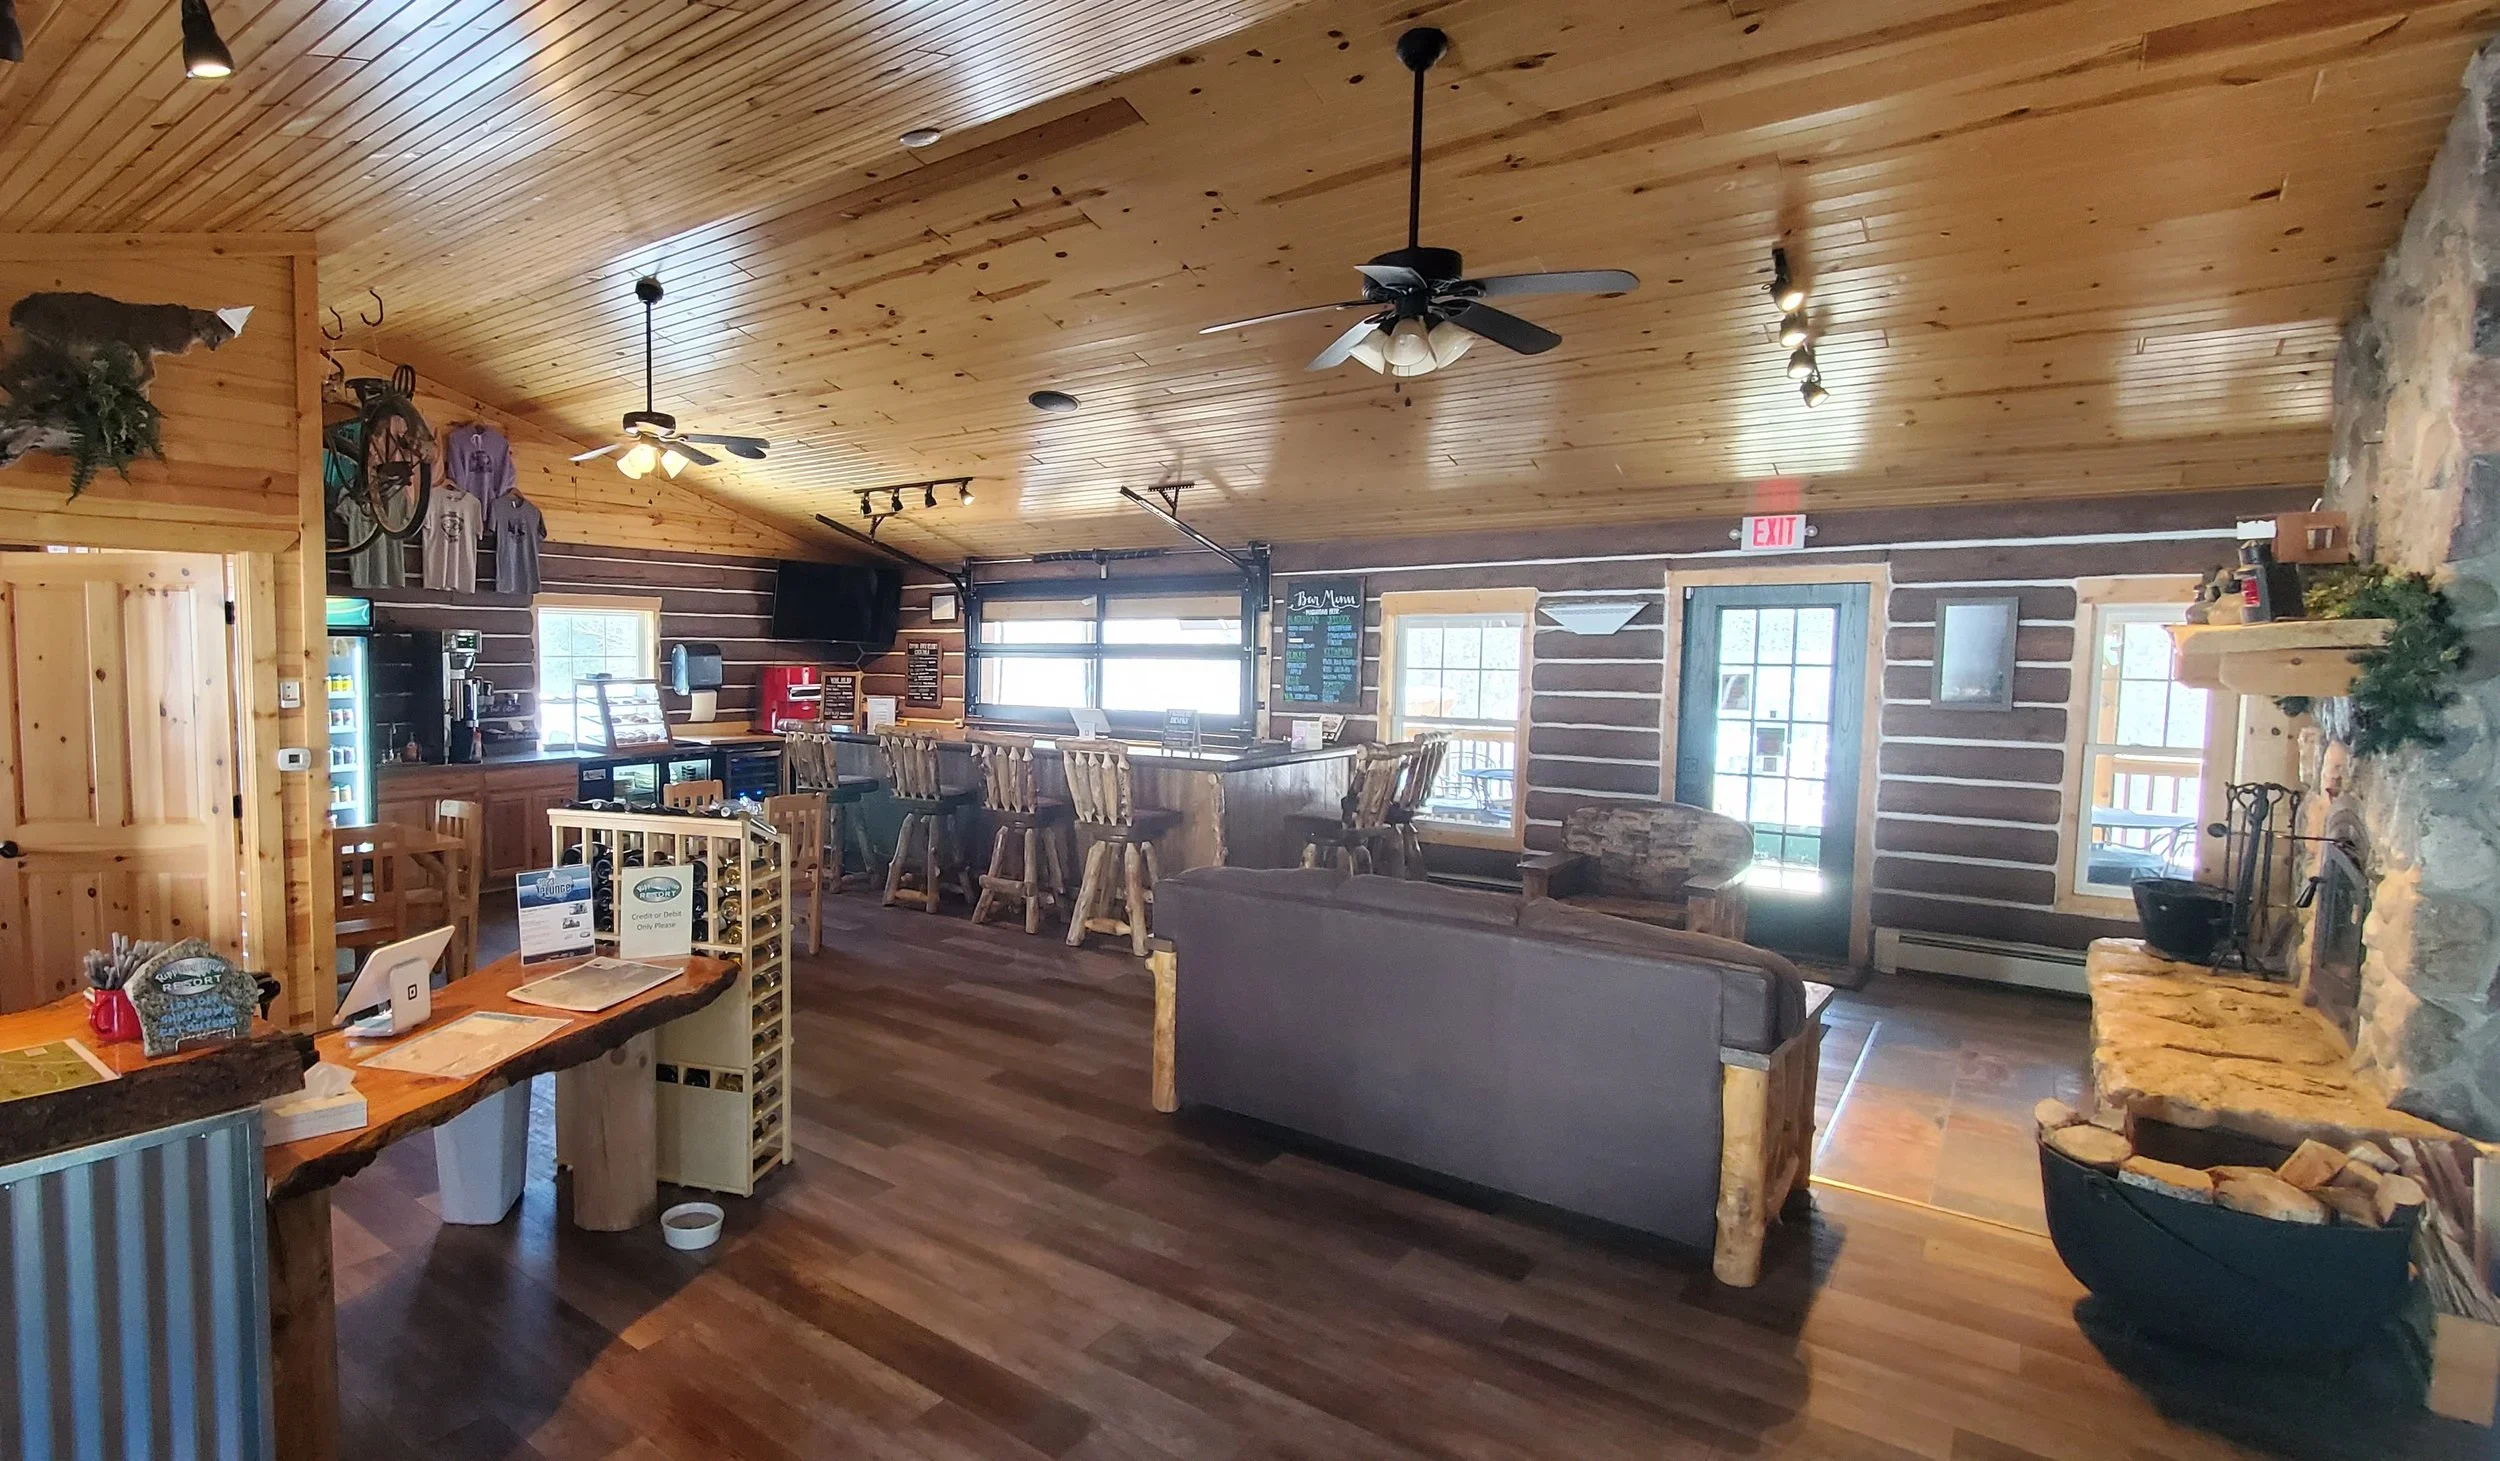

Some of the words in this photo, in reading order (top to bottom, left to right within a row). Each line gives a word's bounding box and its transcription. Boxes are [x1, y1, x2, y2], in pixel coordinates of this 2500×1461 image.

[1753, 517, 1797, 547] EXIT
[1294, 590, 1320, 607] Bar
[1319, 589, 1357, 608] Menu
[631, 912, 653, 920] Credit
[636, 923, 653, 931] Only
[162, 974, 222, 992] RESORT
